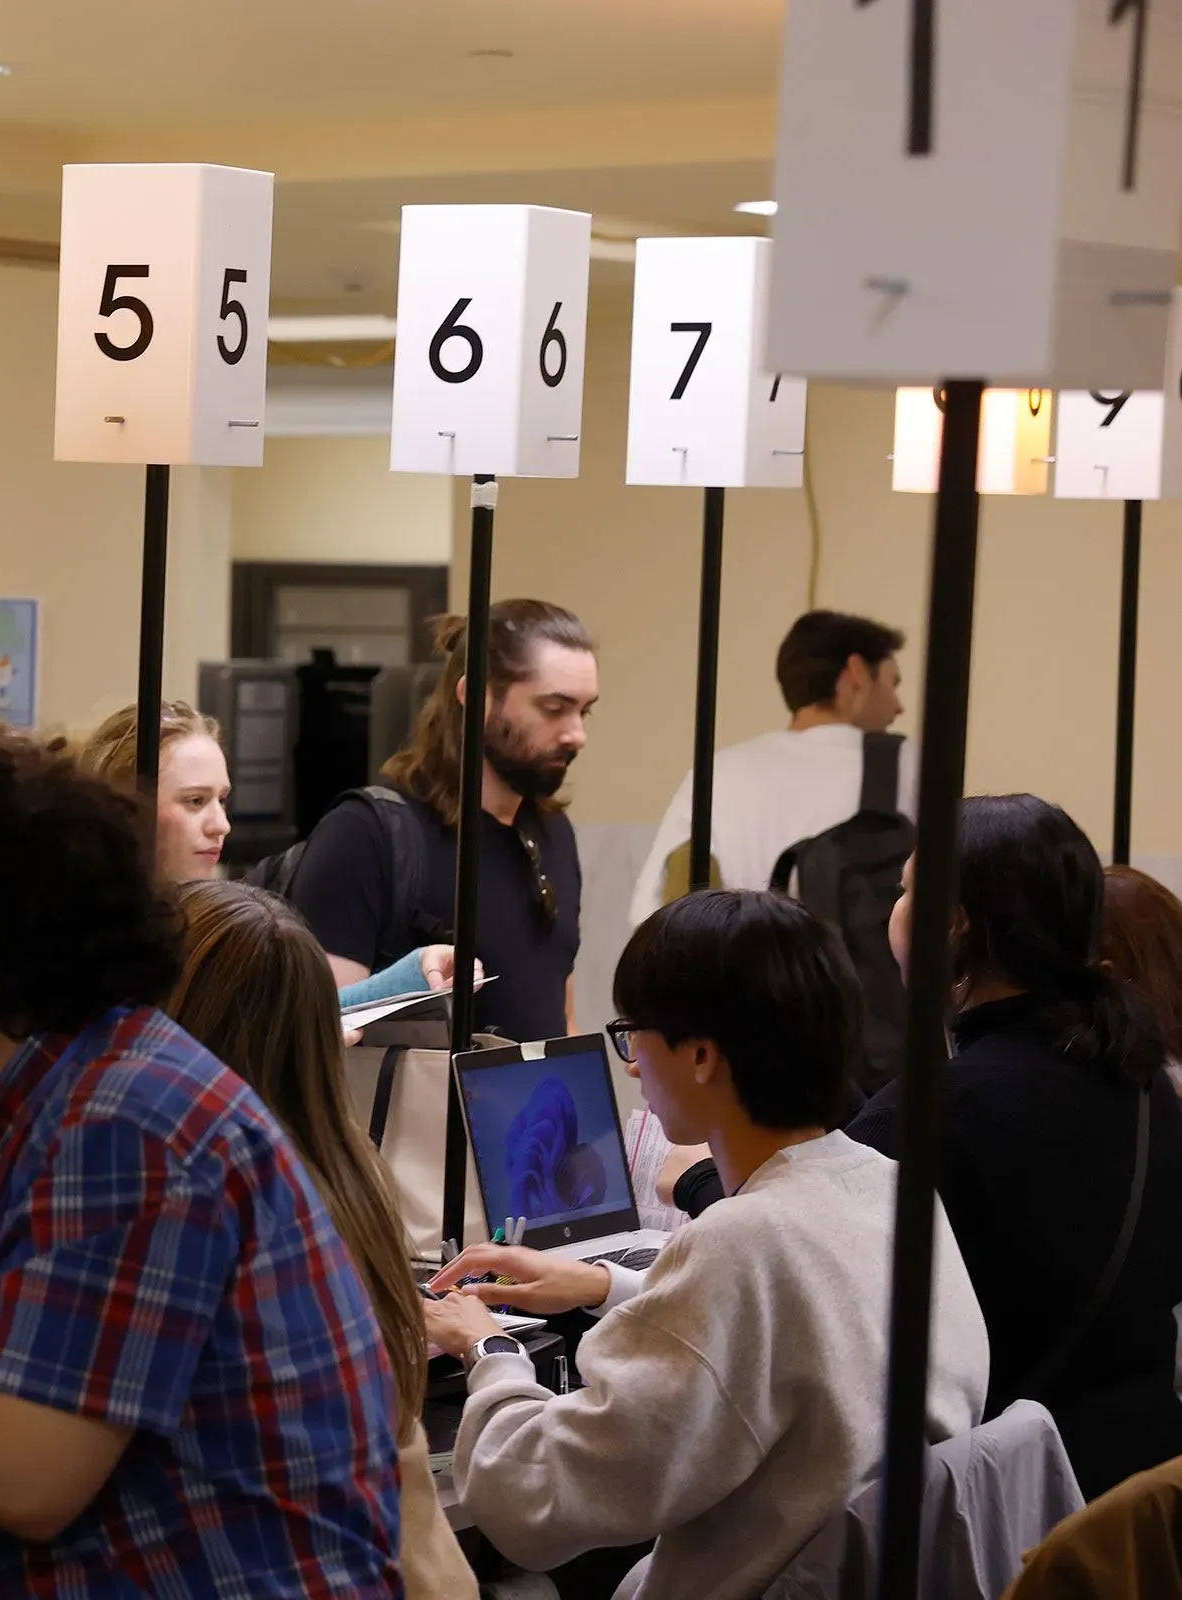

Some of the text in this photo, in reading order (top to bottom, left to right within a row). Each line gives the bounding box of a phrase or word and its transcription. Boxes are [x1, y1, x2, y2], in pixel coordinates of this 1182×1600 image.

[854, 0, 936, 157] 1
[1108, 0, 1149, 191] 1
[94, 264, 154, 362] 5
[216, 267, 248, 366] 5
[428, 297, 484, 384] 6
[539, 301, 567, 388] 6
[670, 322, 712, 400] 7
